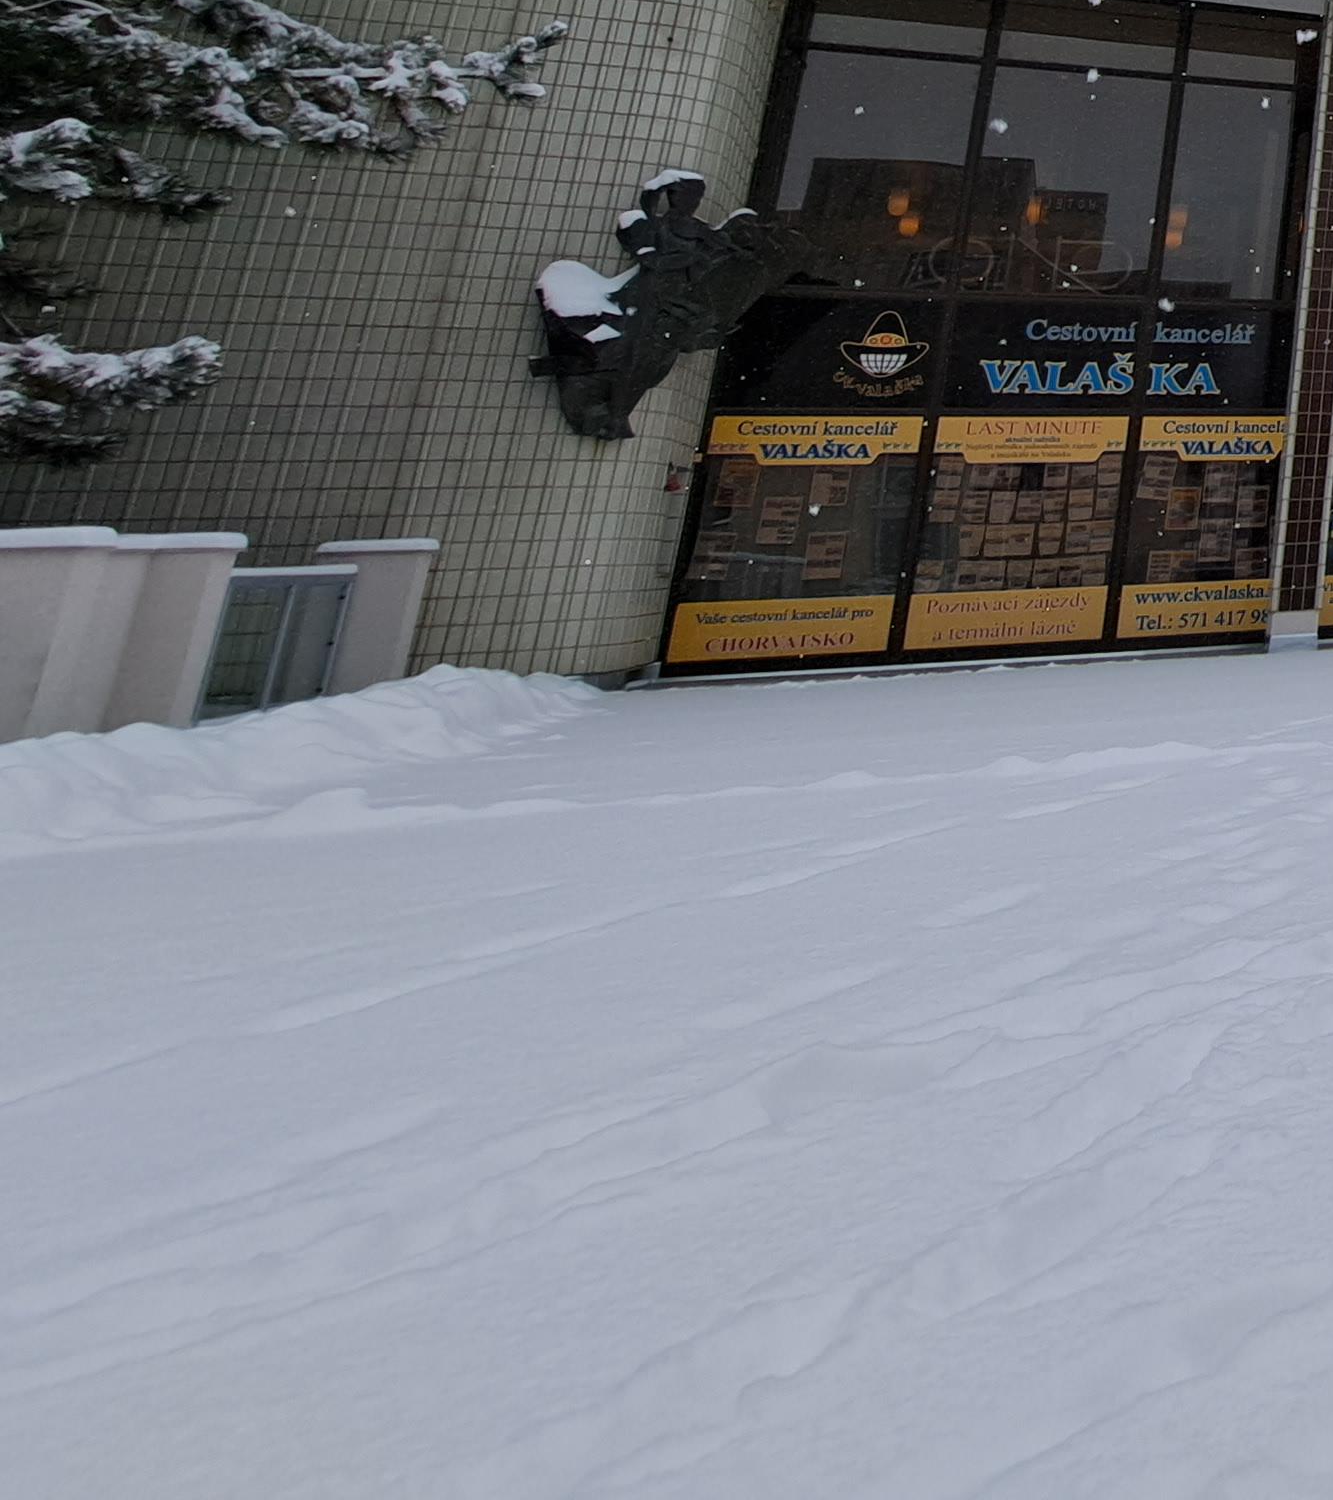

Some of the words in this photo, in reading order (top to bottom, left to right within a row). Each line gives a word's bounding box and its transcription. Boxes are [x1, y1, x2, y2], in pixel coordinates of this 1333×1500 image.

[1026, 319, 1137, 342] Cestovní
[1153, 320, 1256, 345] kancelář
[738, 420, 817, 436] Cestovní
[823, 420, 898, 436] kancelář
[966, 421, 1020, 436] LAST
[1024, 420, 1103, 435] MINUTE
[1163, 420, 1230, 435] Cestovní
[759, 439, 871, 459] VALAŠKA
[1181, 437, 1275, 455] VALAŠKA
[1024, 592, 1090, 613] zájezdy
[1135, 584, 1270, 605] www.ckvalaska.
[696, 611, 728, 625] Vaše
[730, 609, 788, 623] cestovní
[791, 607, 847, 620] kancelář
[851, 608, 874, 621] pro
[1135, 614, 1174, 631] Tel.:
[1178, 612, 1208, 630] 571
[1214, 610, 1244, 628] 417
[1251, 608, 1270, 625] 98
[932, 630, 943, 642] a
[949, 620, 1024, 641] termální
[705, 631, 855, 653] CHORVATSKO
